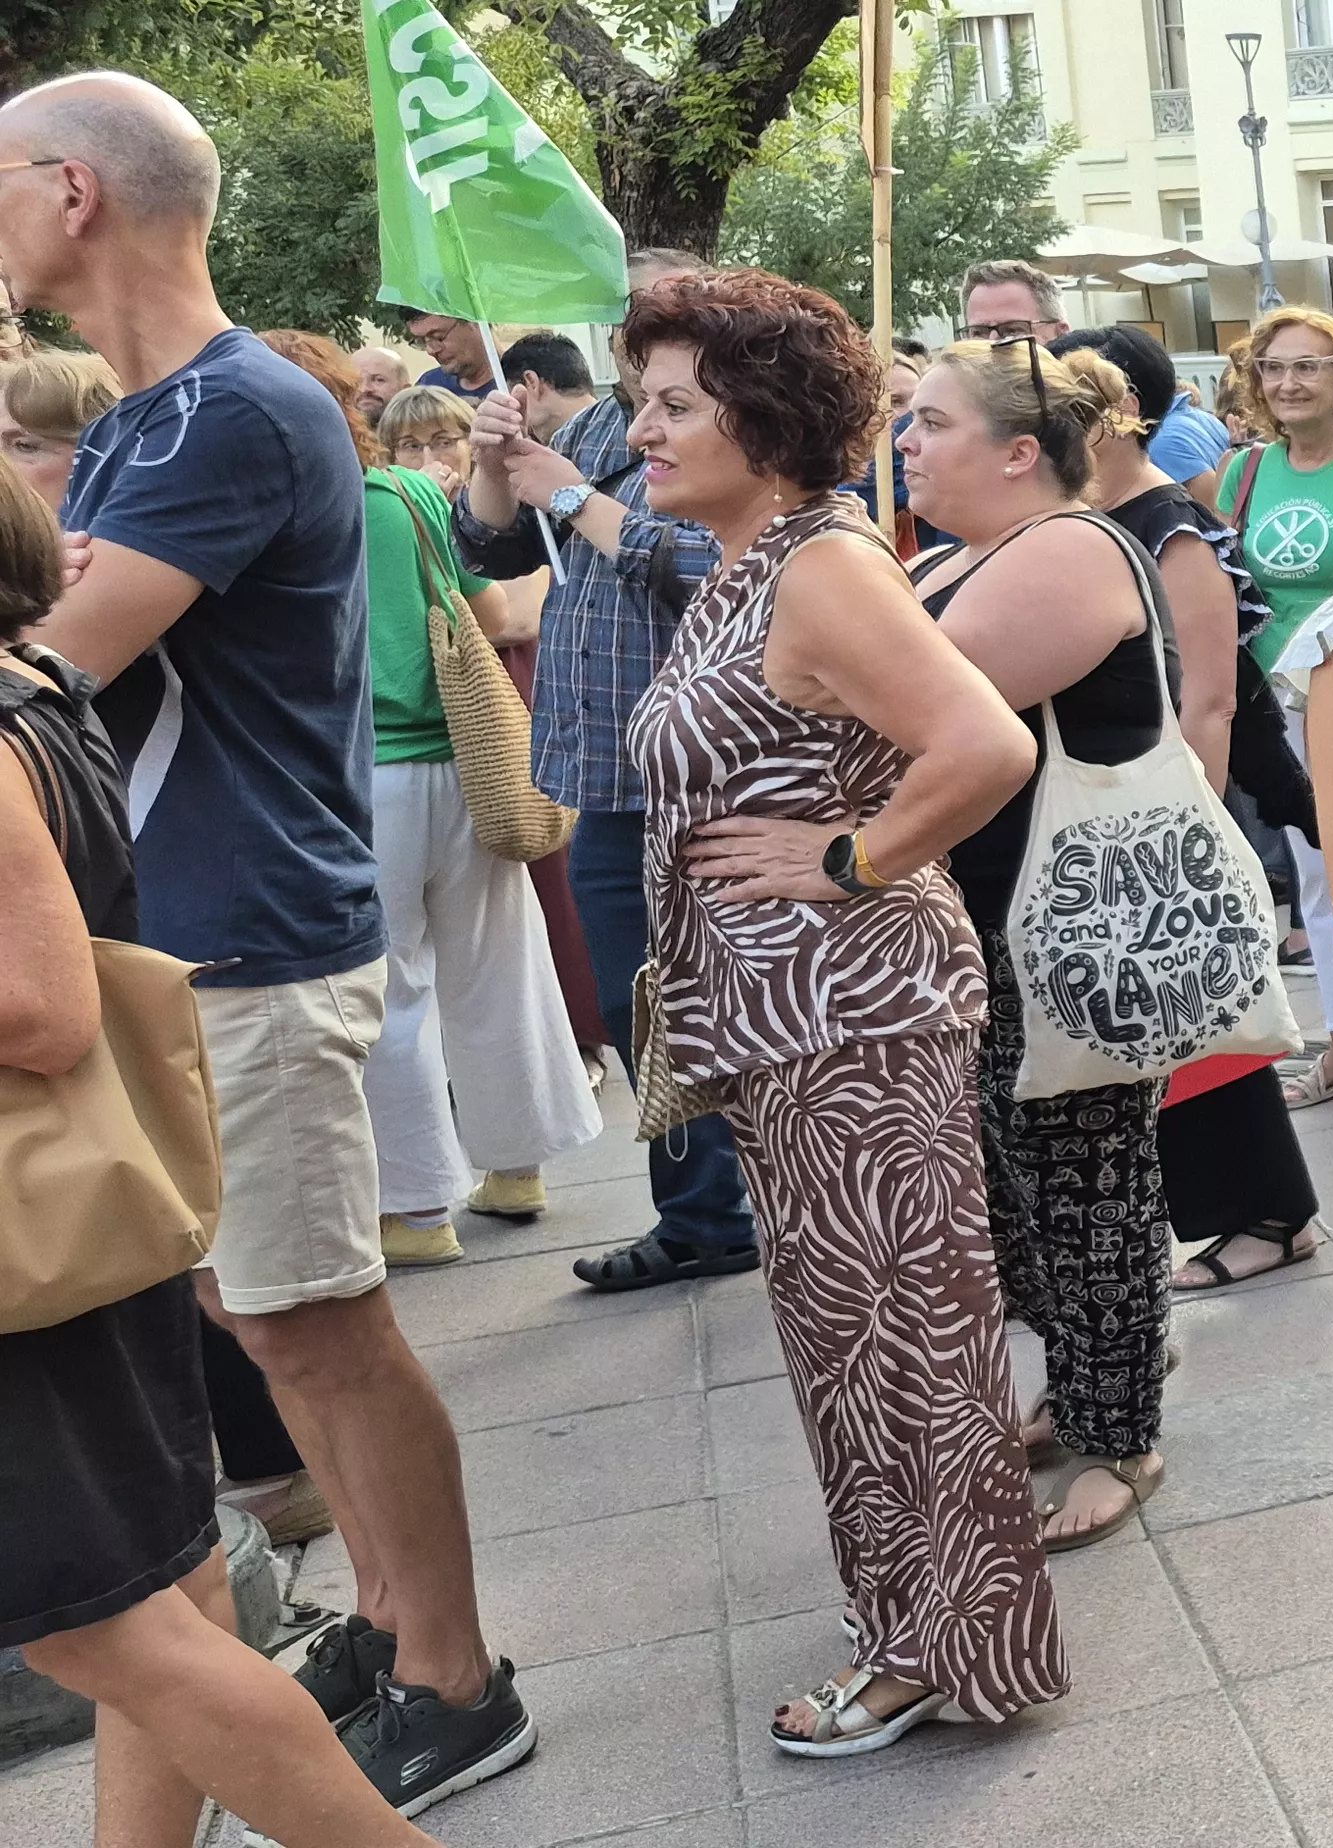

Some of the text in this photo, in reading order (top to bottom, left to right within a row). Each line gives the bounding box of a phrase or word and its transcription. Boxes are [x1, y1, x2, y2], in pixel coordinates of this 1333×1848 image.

[1262, 562, 1320, 580] RECORTES NO
[1058, 918, 1113, 944] and
[1148, 946, 1202, 974] YOUR
